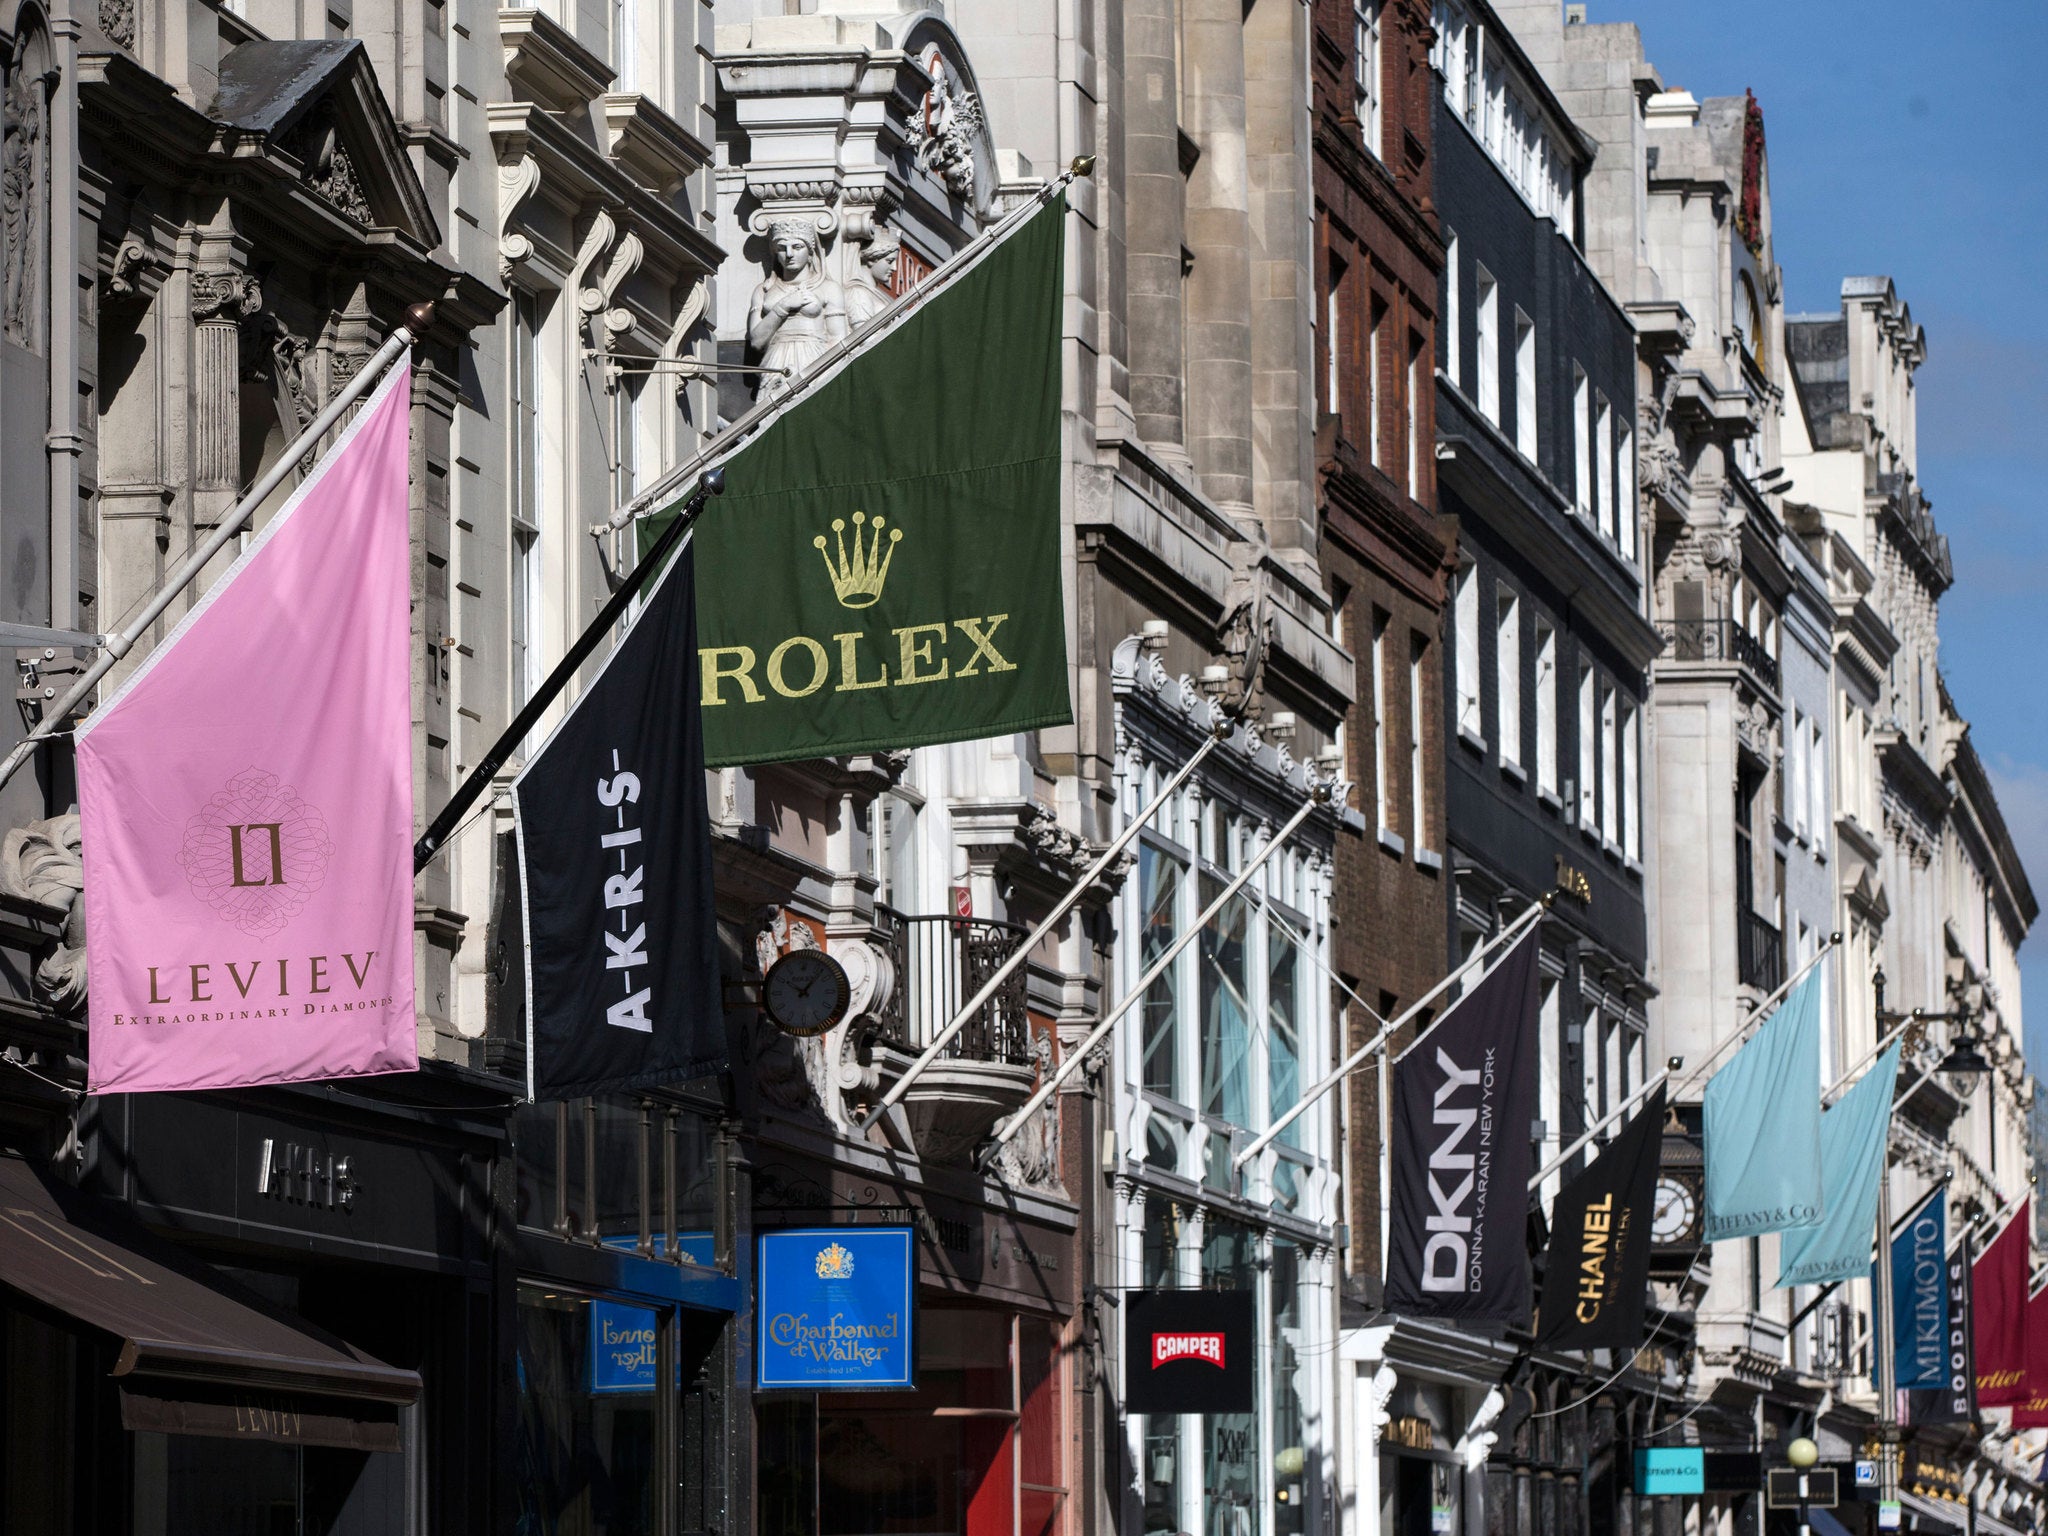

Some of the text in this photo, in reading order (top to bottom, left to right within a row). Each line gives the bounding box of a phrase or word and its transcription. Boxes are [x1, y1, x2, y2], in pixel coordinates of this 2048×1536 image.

[697, 613, 1017, 706] ROLEX
[114, 995, 393, 1025] EXTRAORDINARY DIAMONDS
[148, 952, 374, 1004] LEVIEV
[1421, 1045, 1481, 1292] DKNY
[1470, 1047, 1496, 1292] DONNA KARAN NEW YORK
[1710, 1210, 1773, 1232] TIFFANY
[1576, 1193, 1612, 1324] CHANEL
[770, 1312, 898, 1346] Charbonnel
[1914, 1218, 1941, 1382] MIKIMOTO
[790, 1339, 889, 1366] et Walker
[1156, 1335, 1221, 1361] CAMPER
[1950, 1263, 1967, 1414] BOODLES
